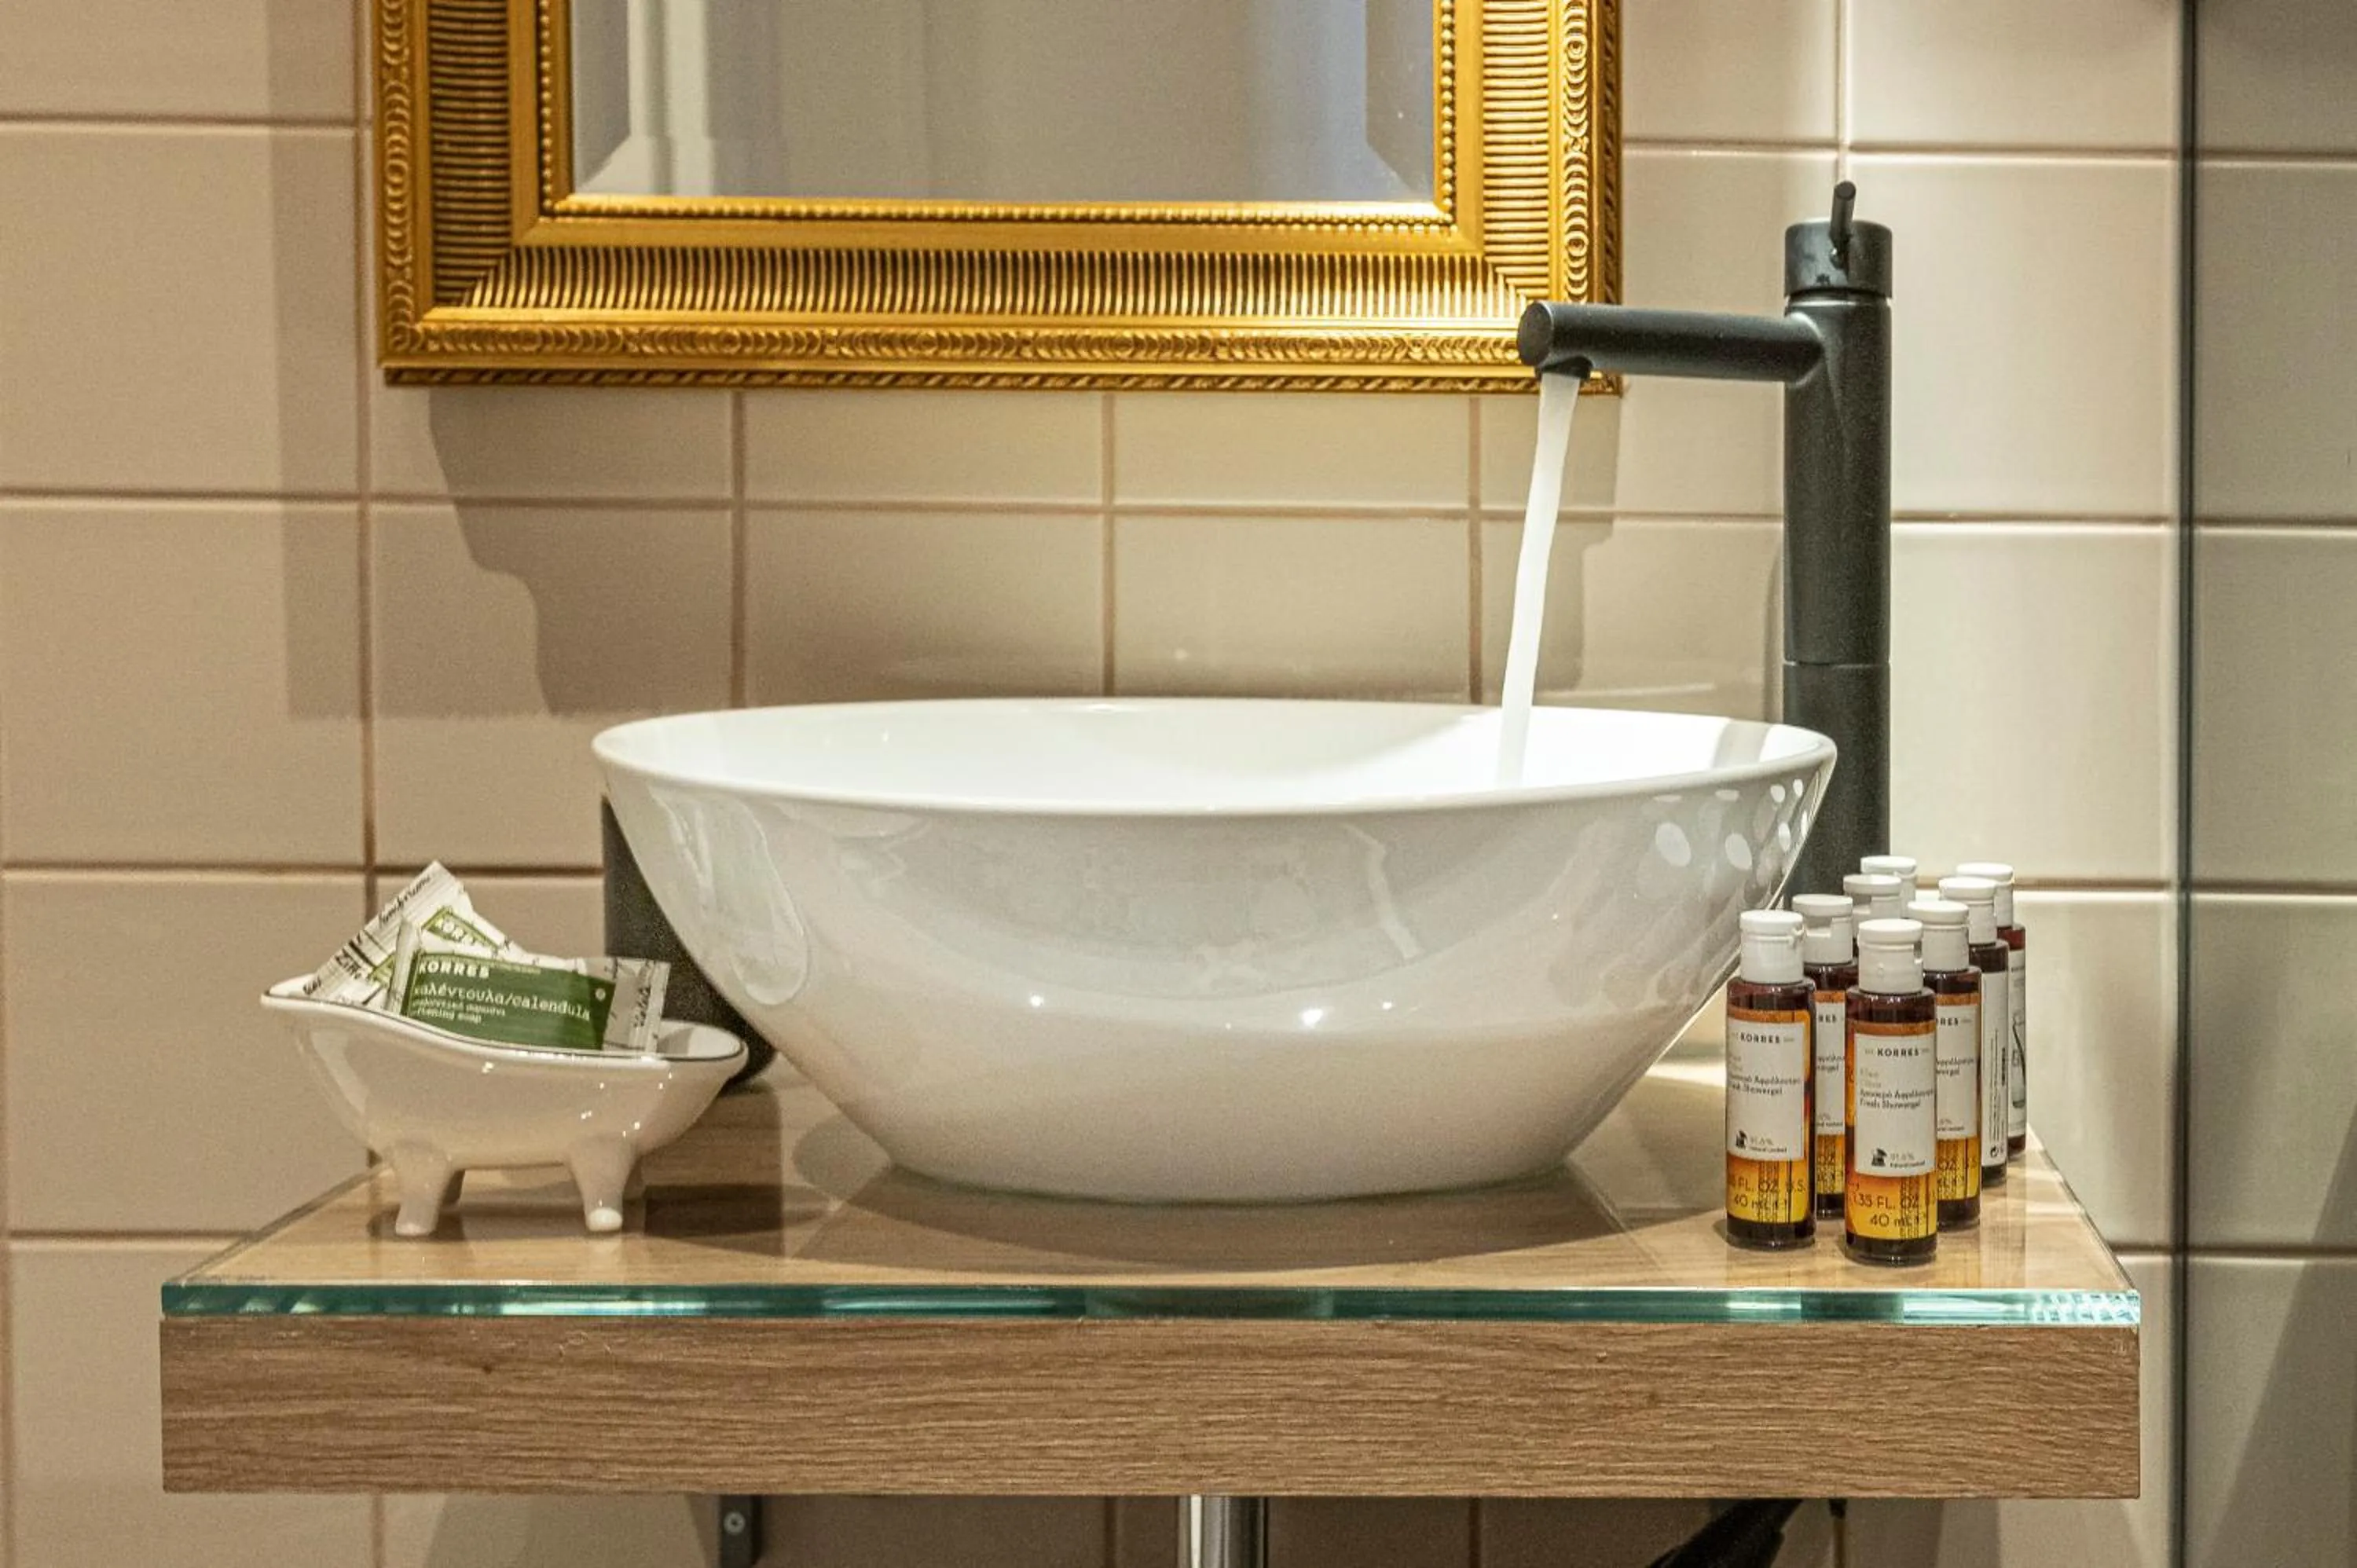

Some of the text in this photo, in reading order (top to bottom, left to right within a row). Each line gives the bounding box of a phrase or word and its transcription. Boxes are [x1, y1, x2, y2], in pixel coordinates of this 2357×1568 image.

[419, 961, 489, 978] KORRES
[1740, 1032, 1780, 1043] KORRES
[1877, 1047, 1919, 1057] KORRES
[1871, 1213, 1890, 1227] 40
